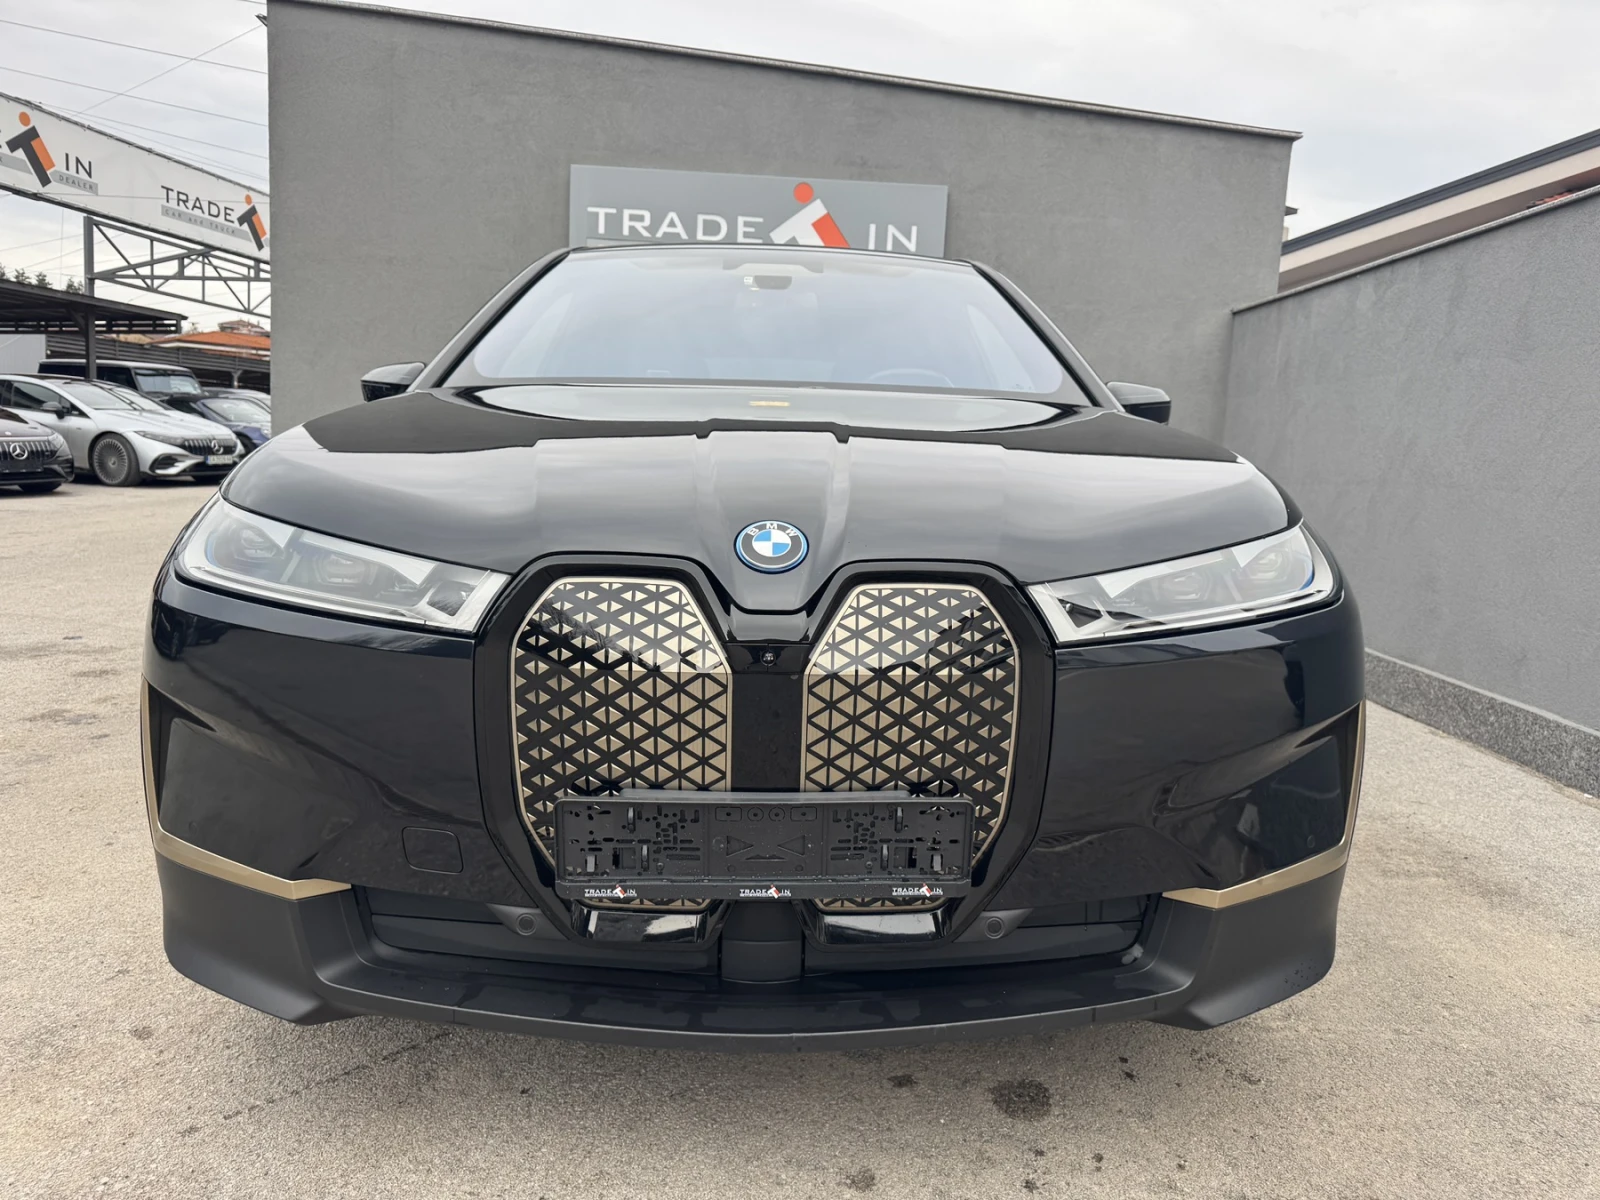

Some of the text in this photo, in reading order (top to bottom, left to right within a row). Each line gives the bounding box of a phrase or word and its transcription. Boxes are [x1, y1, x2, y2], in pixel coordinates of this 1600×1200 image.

[65, 152, 92, 179] IN
[59, 174, 94, 191] DEALER
[161, 185, 235, 224] TRADE
[164, 208, 182, 218] CAR
[209, 221, 235, 234] TRUCK
[587, 206, 917, 252] TRADE IN
[748, 523, 798, 537] BMW
